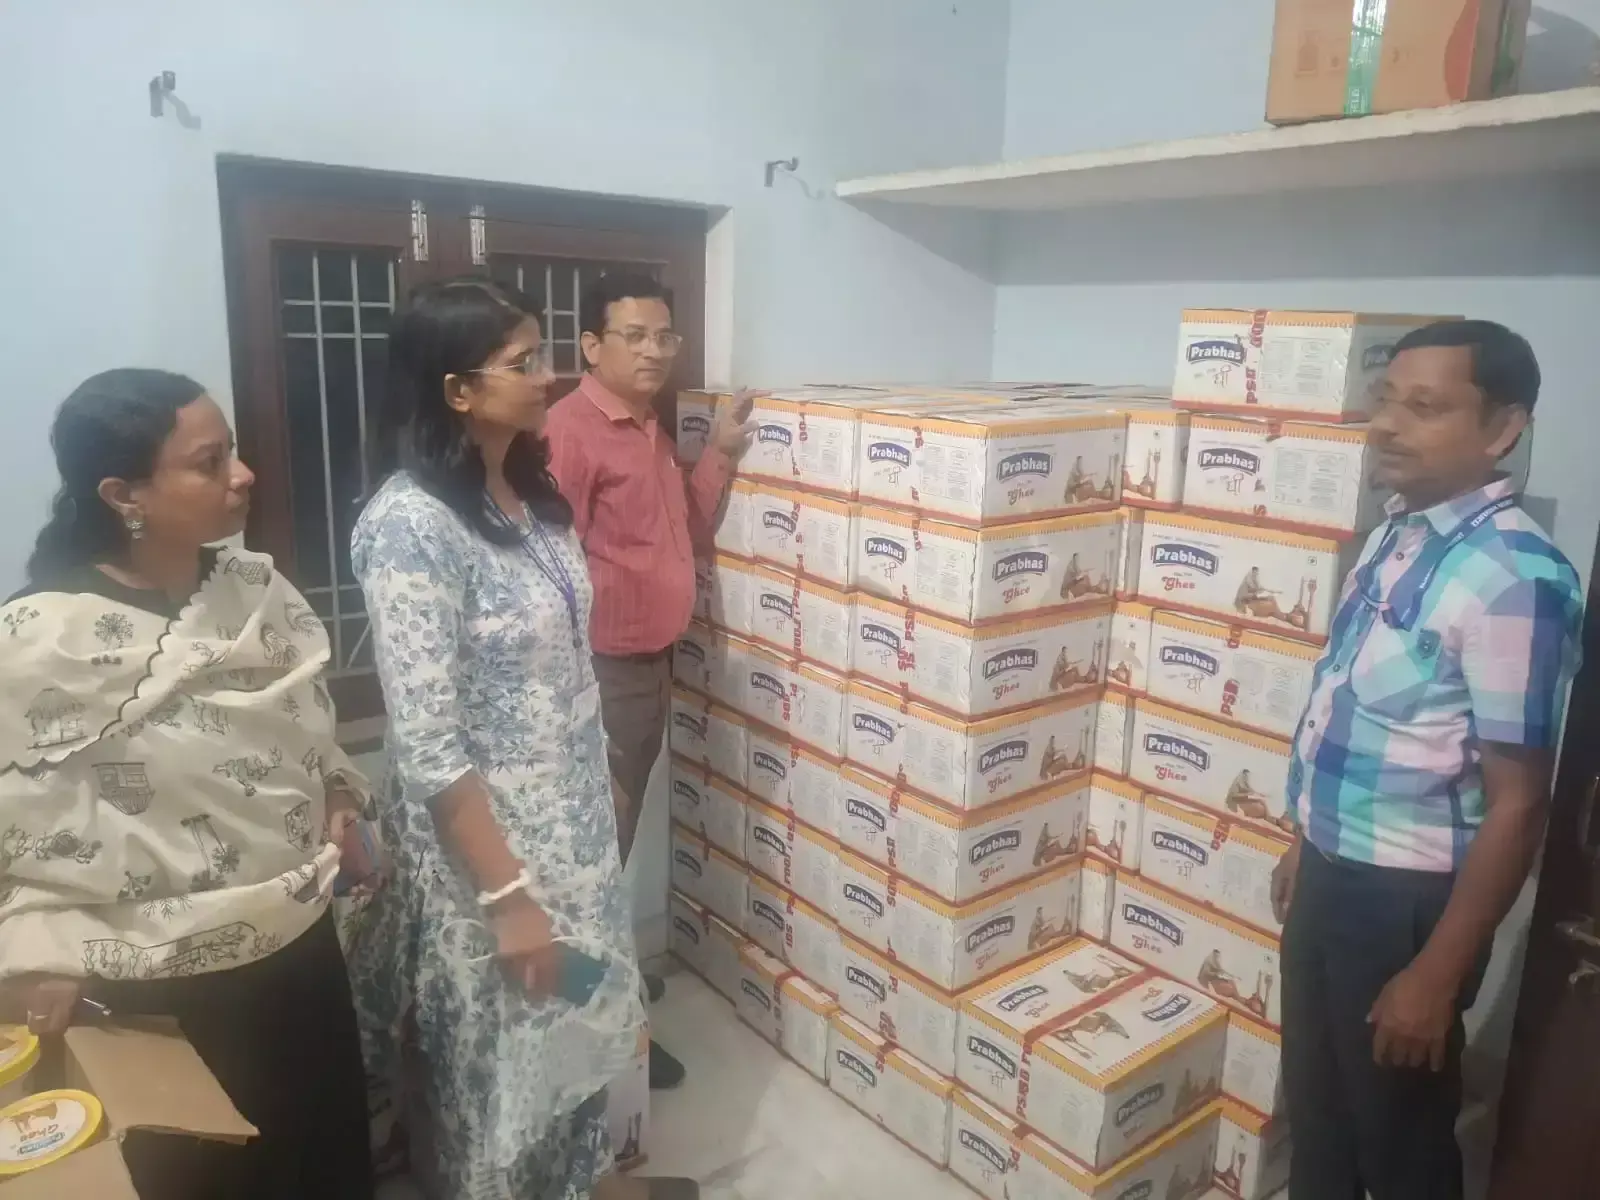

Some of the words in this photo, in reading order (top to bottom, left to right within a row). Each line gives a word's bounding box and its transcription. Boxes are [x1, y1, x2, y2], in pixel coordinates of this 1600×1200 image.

[1191, 346, 1241, 360] Prabhas
[760, 428, 790, 444] Prabhas
[871, 446, 908, 463] Prabhas
[1203, 452, 1254, 469] Prabhas
[1001, 459, 1048, 475] Prabhas
[868, 541, 904, 560] Prabhas
[1156, 547, 1213, 570] Prabhas
[997, 559, 1043, 577] Prabhas
[1162, 576, 1196, 591] Ghee
[863, 626, 898, 647] Prabhas
[987, 654, 1033, 675] Prabhas
[1163, 648, 1214, 671] Prabhas
[855, 716, 891, 739] Prabhas
[981, 745, 1024, 769] Prabhas
[1148, 736, 1204, 766] Prabhas
[1154, 764, 1188, 781] Ghee
[849, 801, 885, 828] Prabhas
[973, 835, 1017, 862] Prabhas
[1155, 834, 1203, 863] Prabhas
[846, 886, 882, 913] Prabhas
[1126, 906, 1178, 942] Prabhas
[970, 1039, 1014, 1075] Prabhas
[962, 1132, 1004, 1169] Prabhas
